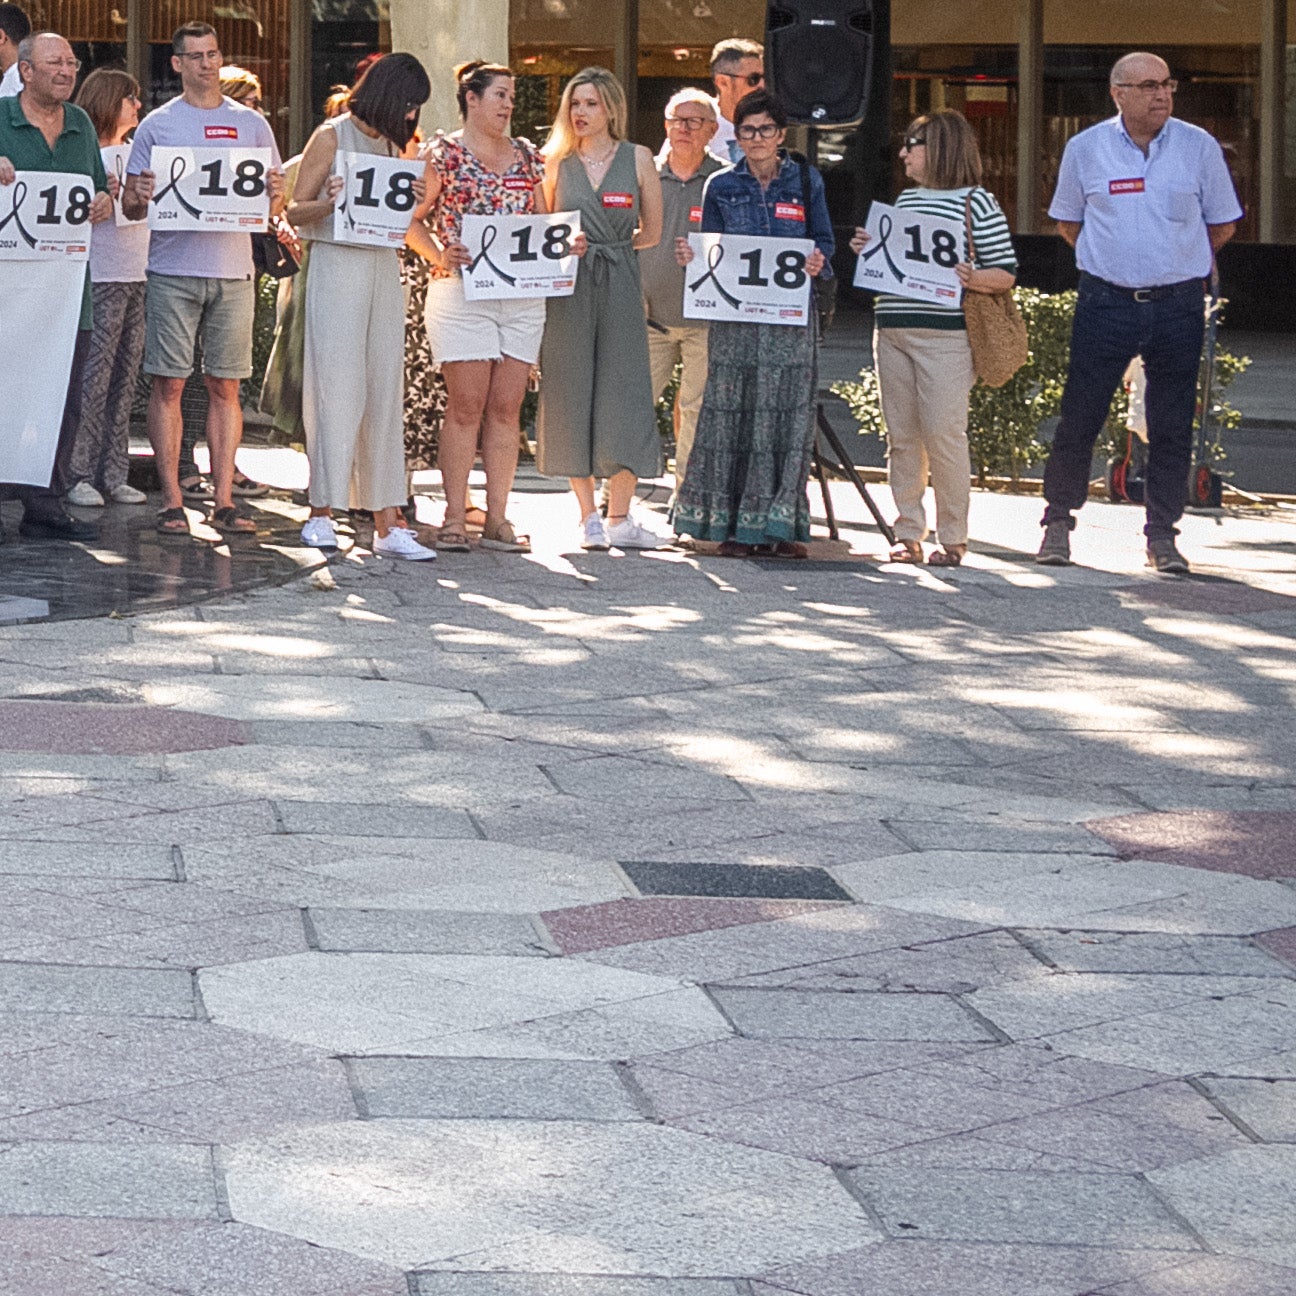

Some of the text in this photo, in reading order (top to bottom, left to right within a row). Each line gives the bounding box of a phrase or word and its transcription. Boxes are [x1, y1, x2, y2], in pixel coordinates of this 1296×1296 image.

[199, 159, 265, 197] 18
[354, 167, 417, 212] 18
[37, 185, 91, 225] 18
[158, 211, 178, 219] 2024
[0, 240, 18, 249] 2024
[509, 223, 572, 263] 18
[904, 224, 959, 269] 18
[475, 280, 495, 288] 2024
[738, 248, 807, 290] 18
[865, 268, 883, 279] 2024
[695, 299, 716, 308] 2024
